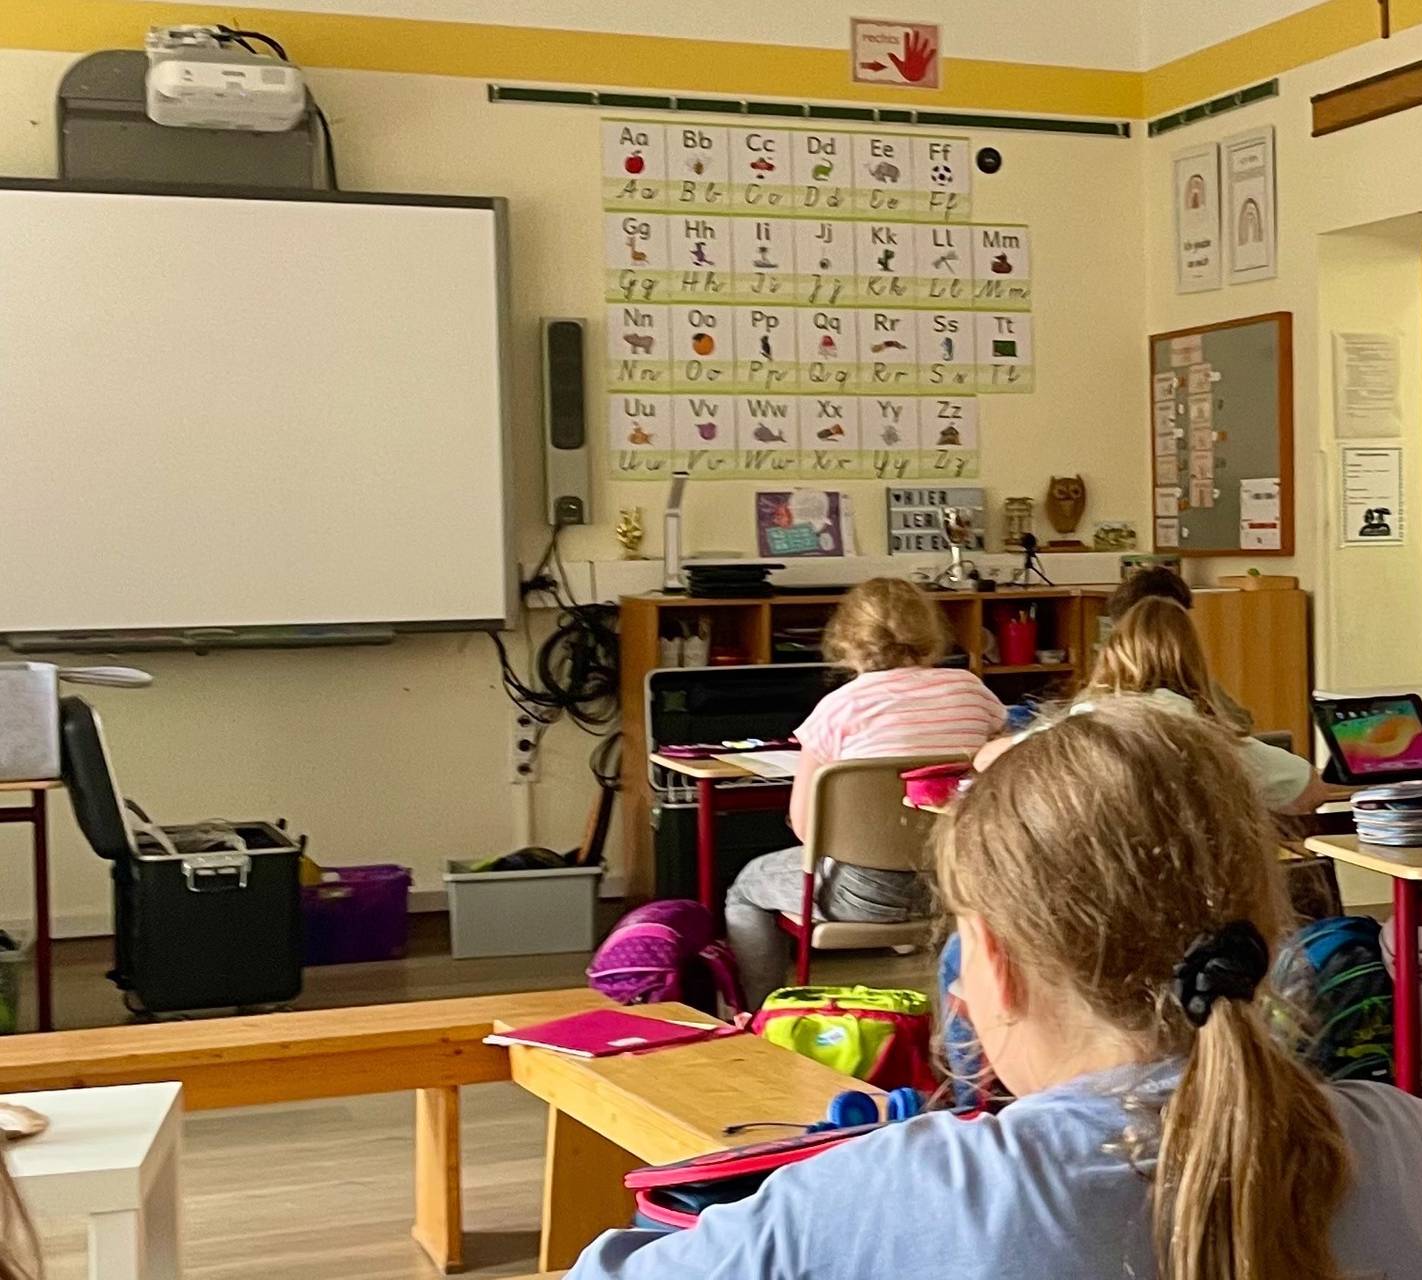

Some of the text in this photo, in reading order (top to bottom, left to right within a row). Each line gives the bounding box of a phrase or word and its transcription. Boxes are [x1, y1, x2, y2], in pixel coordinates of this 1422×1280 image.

[619, 127, 649, 147] Aa
[683, 130, 713, 149] Bb
[746, 133, 776, 152] Cc
[807, 136, 837, 155] Dd
[870, 139, 895, 158] Ee
[929, 143, 952, 161] Ff
[622, 217, 651, 240] Gg
[685, 219, 716, 239] Hh
[815, 223, 833, 243] Jj
[871, 226, 897, 245] Kk
[932, 228, 954, 247] Ll
[982, 231, 1020, 249] Mm
[623, 307, 654, 328] Nn
[688, 309, 717, 328] Oo
[751, 310, 780, 333] Pp
[813, 312, 842, 334] Qq
[874, 313, 901, 332] Rr
[933, 315, 959, 333] Ss
[993, 316, 1015, 334] Tt
[624, 398, 656, 417] Uu
[688, 398, 719, 417] Vv
[747, 398, 788, 418] Ww
[817, 400, 844, 418] Xx
[877, 400, 903, 423] Yy
[936, 400, 963, 419] Zz
[893, 535, 923, 551] DIE
